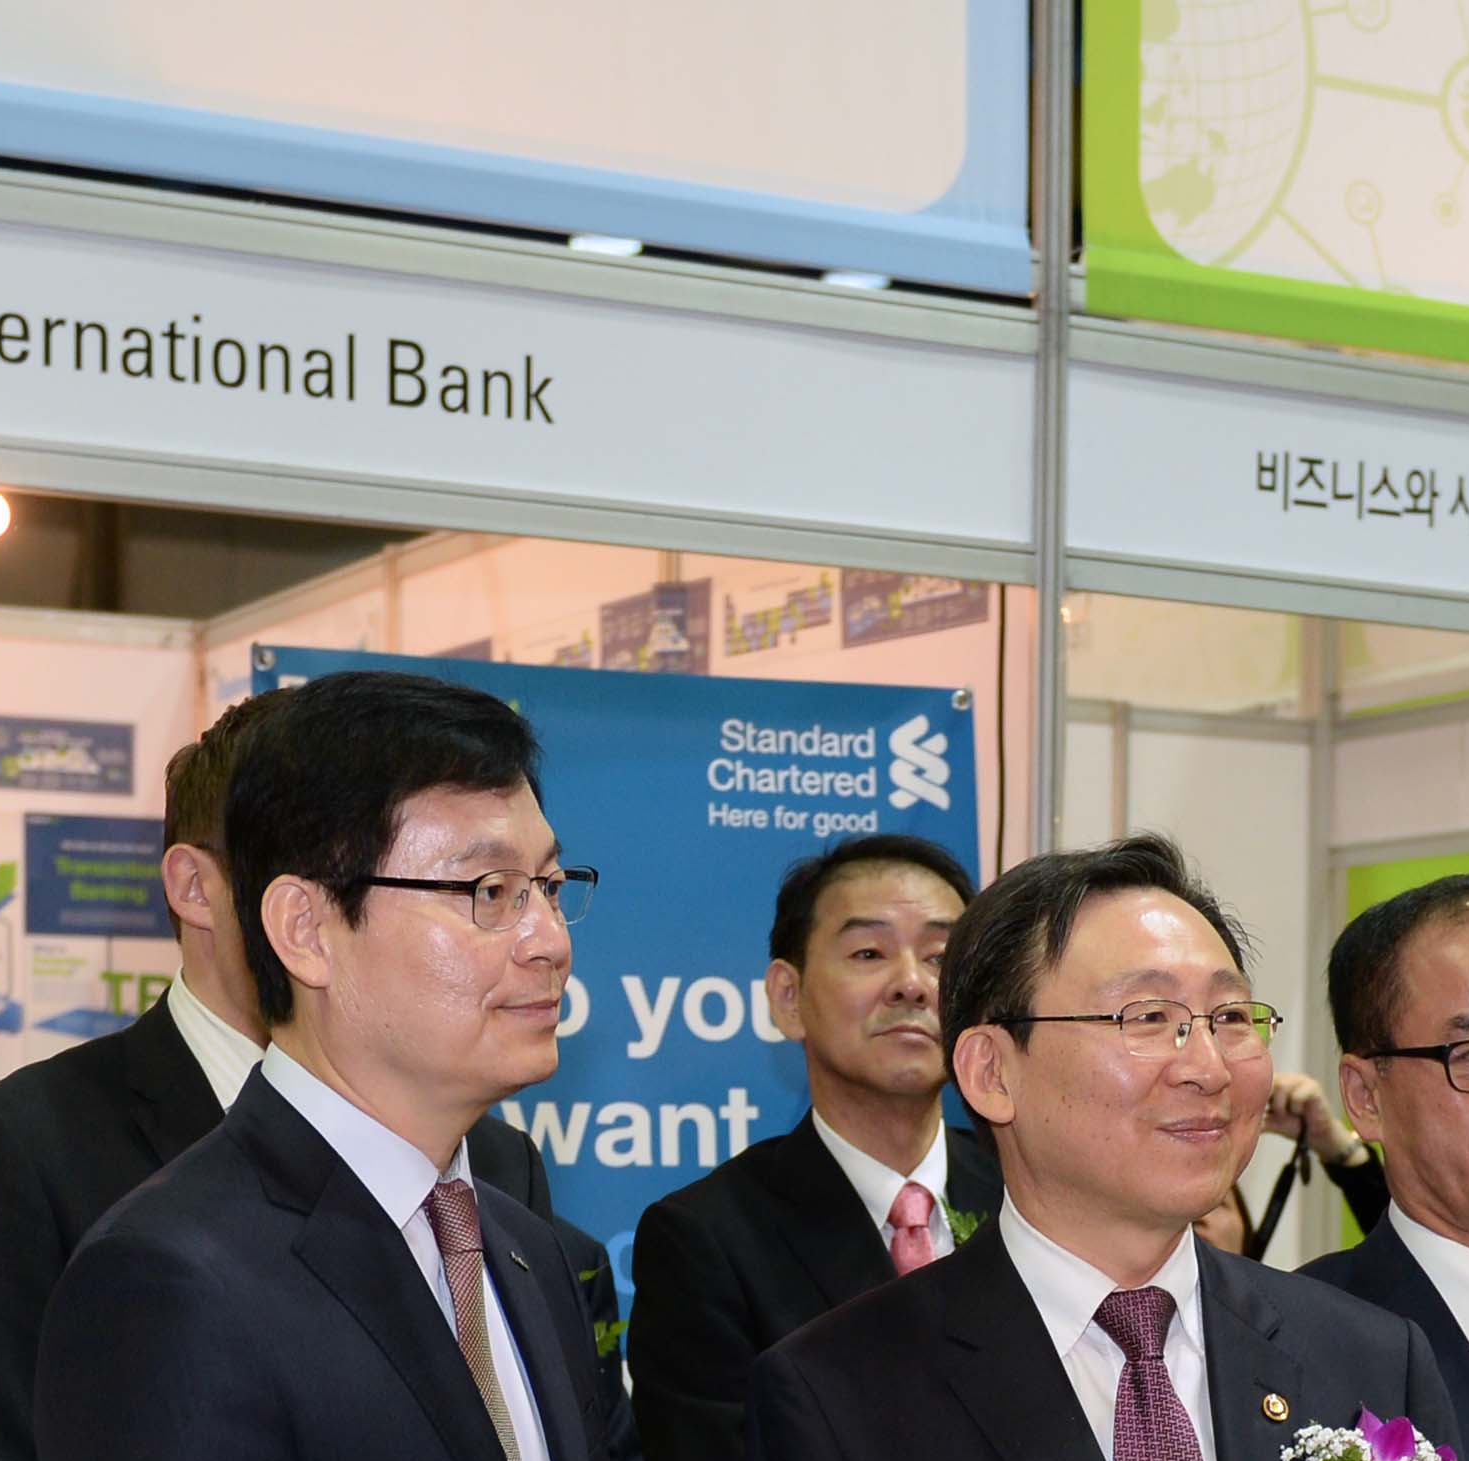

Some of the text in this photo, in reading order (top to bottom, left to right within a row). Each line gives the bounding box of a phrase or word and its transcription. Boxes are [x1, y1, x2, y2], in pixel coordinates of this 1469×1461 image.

[386, 338, 557, 425] Bank
[1256, 450, 1439, 528] 비즈니스와
[720, 718, 876, 759] Standard
[707, 758, 877, 798] Chartered
[708, 803, 879, 837] Here for good
[70, 883, 149, 906] Banking
[500, 1087, 760, 1168] want
